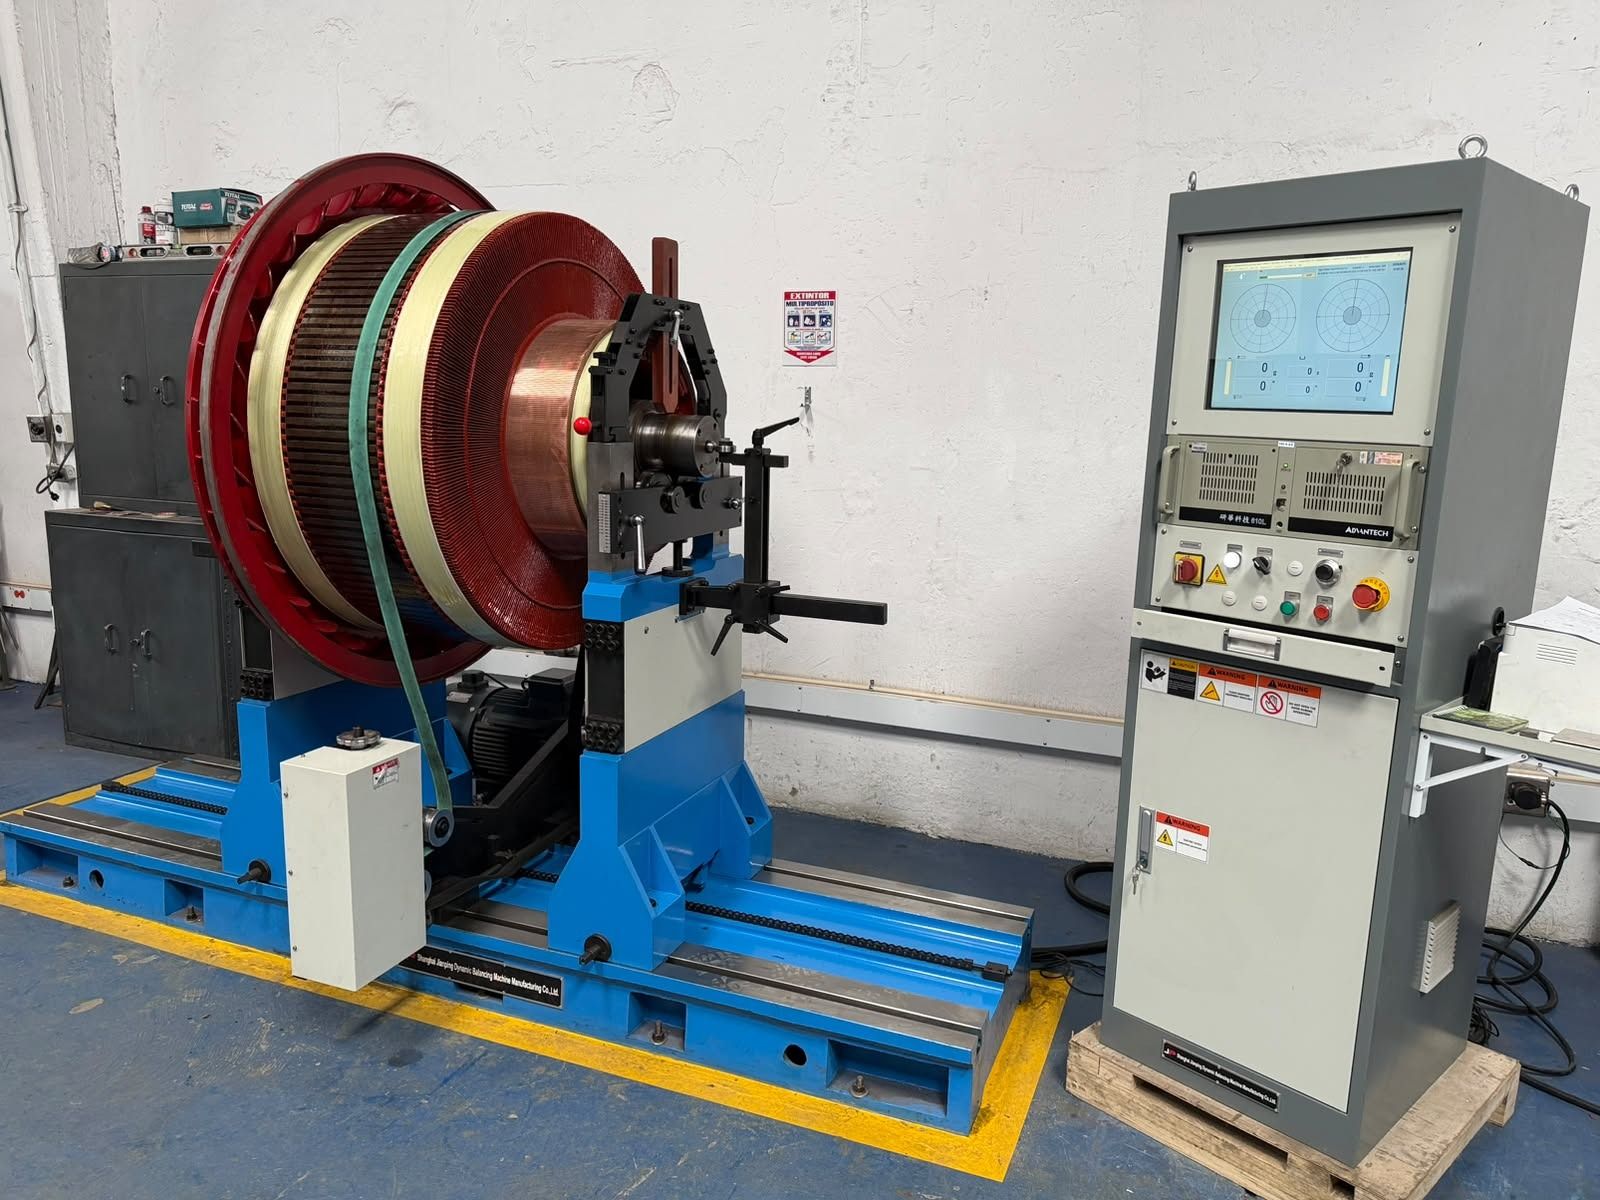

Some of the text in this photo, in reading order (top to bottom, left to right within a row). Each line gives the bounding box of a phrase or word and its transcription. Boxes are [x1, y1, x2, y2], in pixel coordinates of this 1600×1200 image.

[790, 292, 829, 300] EXTINTOR
[1345, 526, 1389, 537] ADVANTECH
[1216, 669, 1246, 681] WARNING
[1277, 681, 1309, 694] WARNING
[1172, 818, 1201, 831] WARNING
[472, 967, 493, 981] Balancing
[493, 972, 511, 984] Machine
[511, 977, 541, 994] Manufacturing
